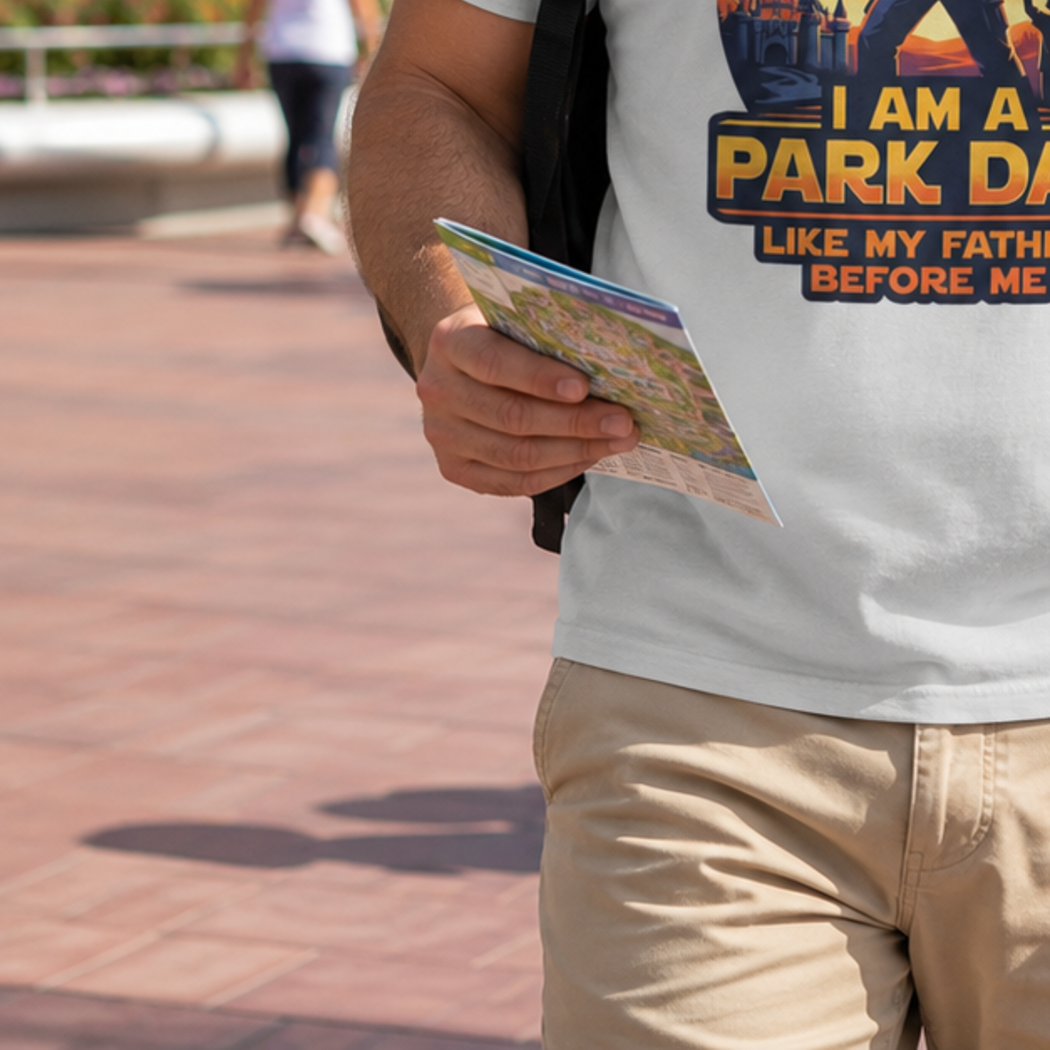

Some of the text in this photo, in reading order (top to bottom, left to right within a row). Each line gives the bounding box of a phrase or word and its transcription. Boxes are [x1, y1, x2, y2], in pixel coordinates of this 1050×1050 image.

[833, 85, 1029, 131] I AM A
[716, 135, 942, 205] PARK
[763, 226, 849, 257] LIKE
[865, 229, 926, 259] MY
[811, 264, 1047, 295] BEFORE ME
